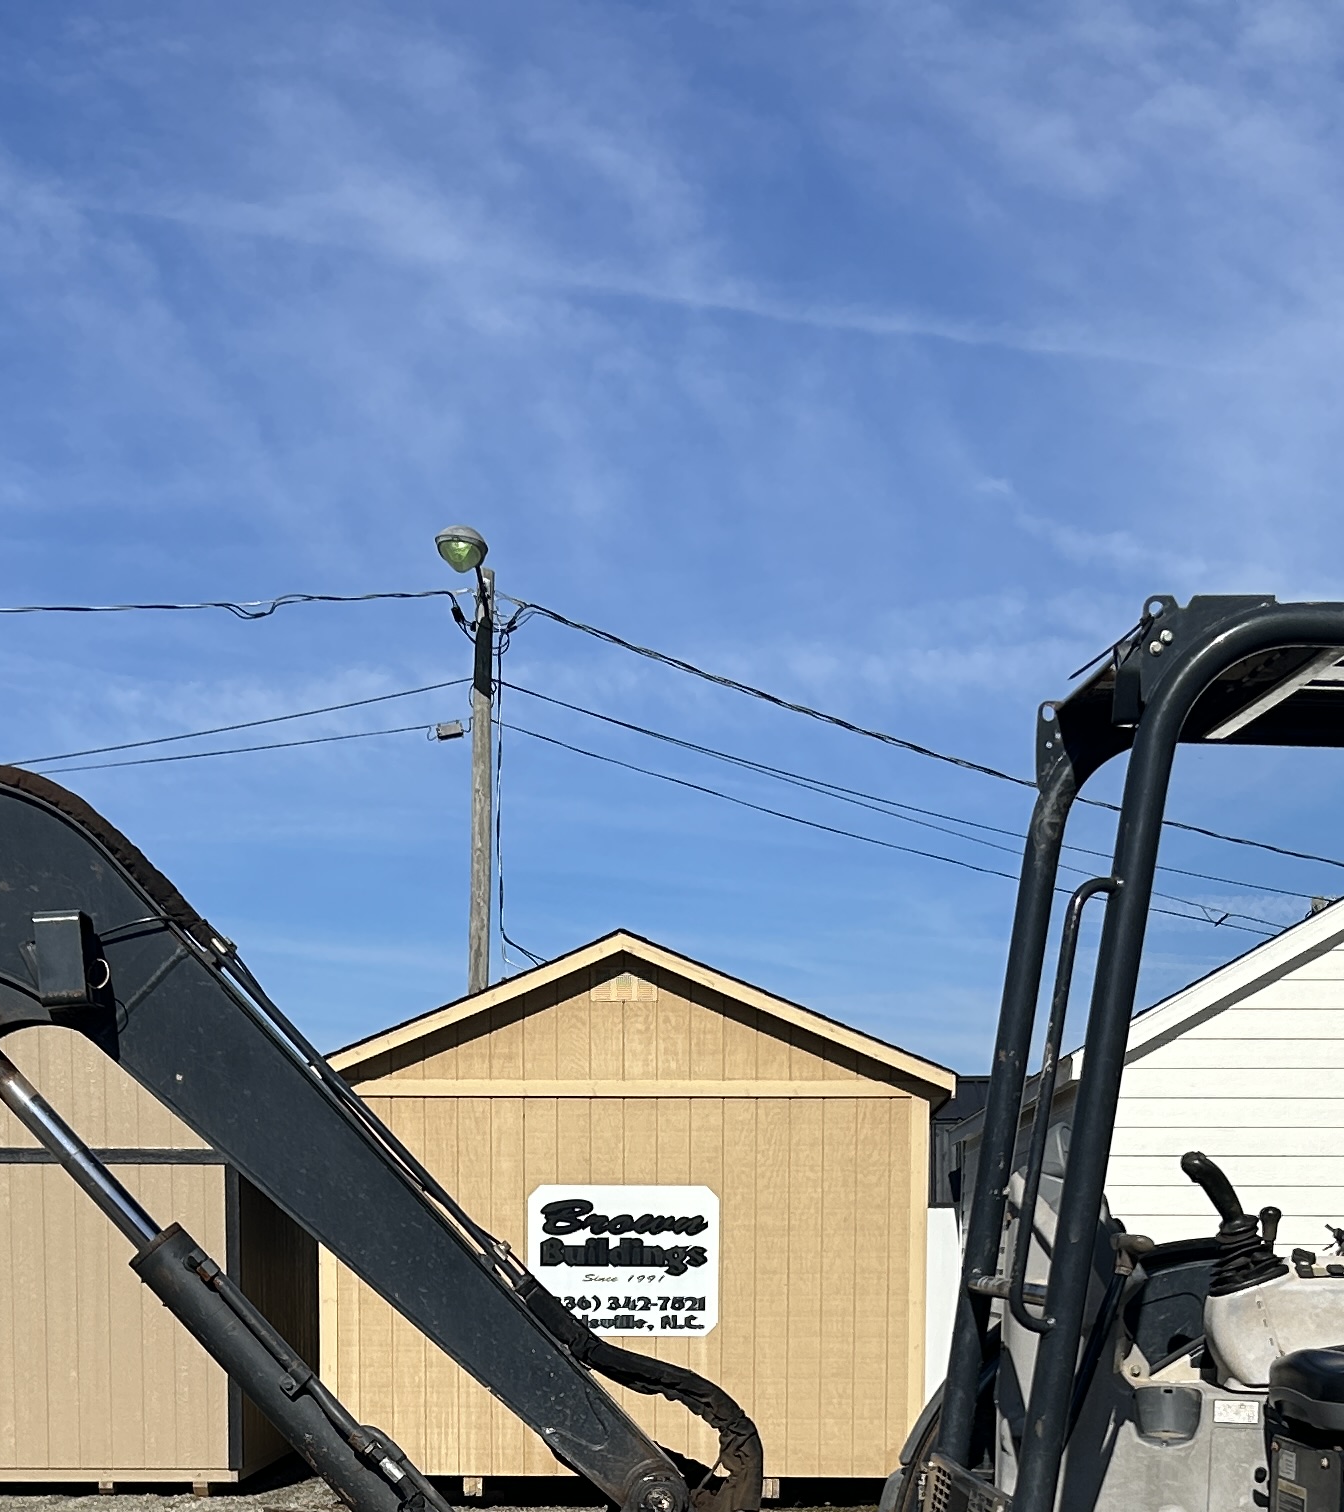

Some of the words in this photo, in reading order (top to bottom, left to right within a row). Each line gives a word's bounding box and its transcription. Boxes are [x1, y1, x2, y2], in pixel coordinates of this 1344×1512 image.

[540, 1198, 708, 1236] Brown
[539, 1236, 708, 1276] Buildings
[582, 1273, 619, 1283] Since
[627, 1274, 665, 1284] 1991
[660, 1314, 705, 1330] N.C.
